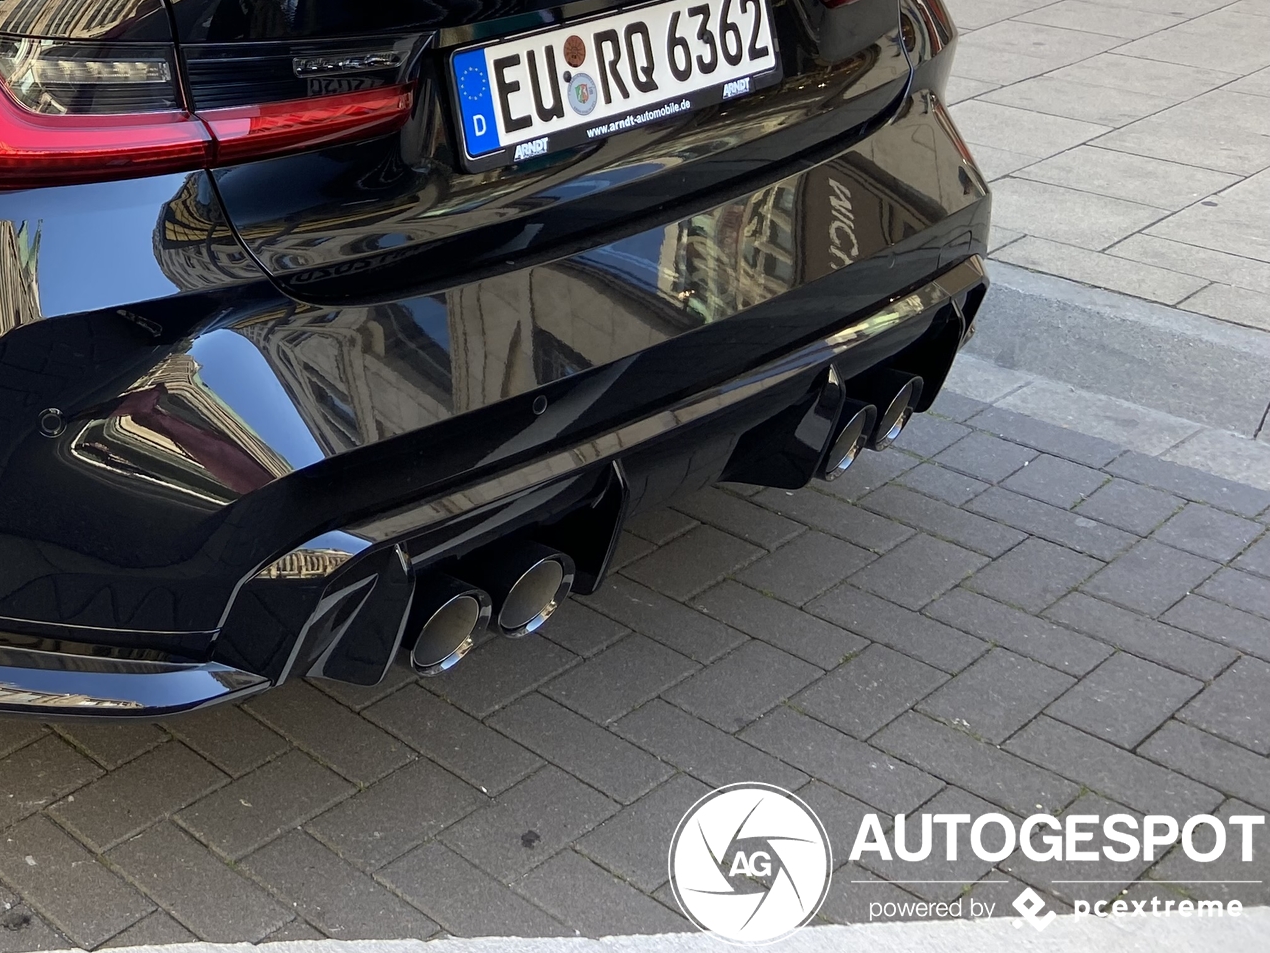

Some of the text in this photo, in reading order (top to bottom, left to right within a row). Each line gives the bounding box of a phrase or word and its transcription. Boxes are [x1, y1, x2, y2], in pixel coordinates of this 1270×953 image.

[493, 43, 565, 133] EU
[593, 21, 659, 105] RQ
[723, 77, 750, 98] ARNDT
[473, 113, 487, 137] D
[586, 98, 691, 138] www.arndt-automobile.de
[514, 136, 549, 160] ARNDT
